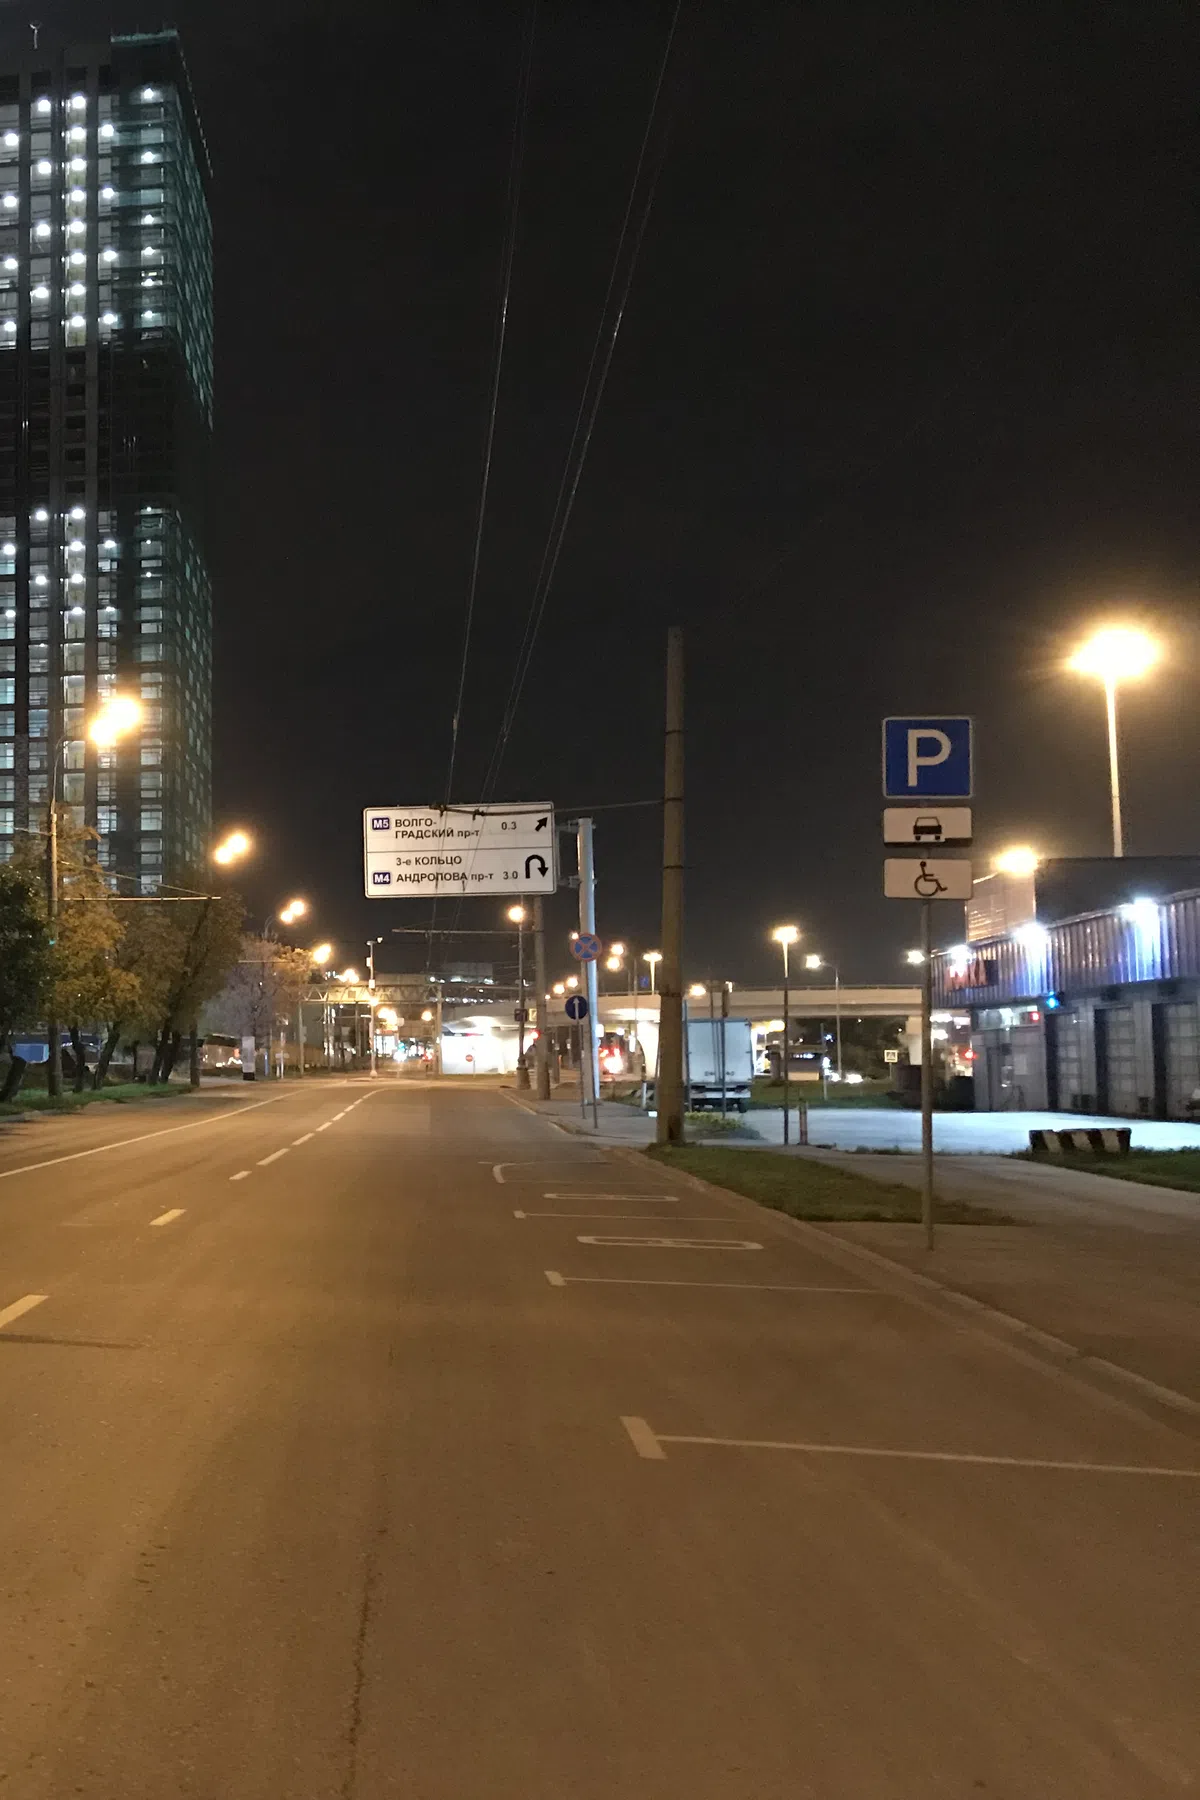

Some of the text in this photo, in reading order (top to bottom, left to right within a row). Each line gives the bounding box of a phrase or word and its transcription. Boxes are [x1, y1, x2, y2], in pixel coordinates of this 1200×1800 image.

[907, 729, 951, 786] P
[373, 818, 437, 829] М5 ВОЛГО-
[501, 822, 517, 831] 0.3
[395, 828, 480, 839] ГРАДСКИЙ пр-т
[396, 856, 462, 866] 3-е КОЛЬЦО
[374, 872, 494, 884] М4 АНДРОПОВА пр-т
[503, 871, 518, 880] 3.0
